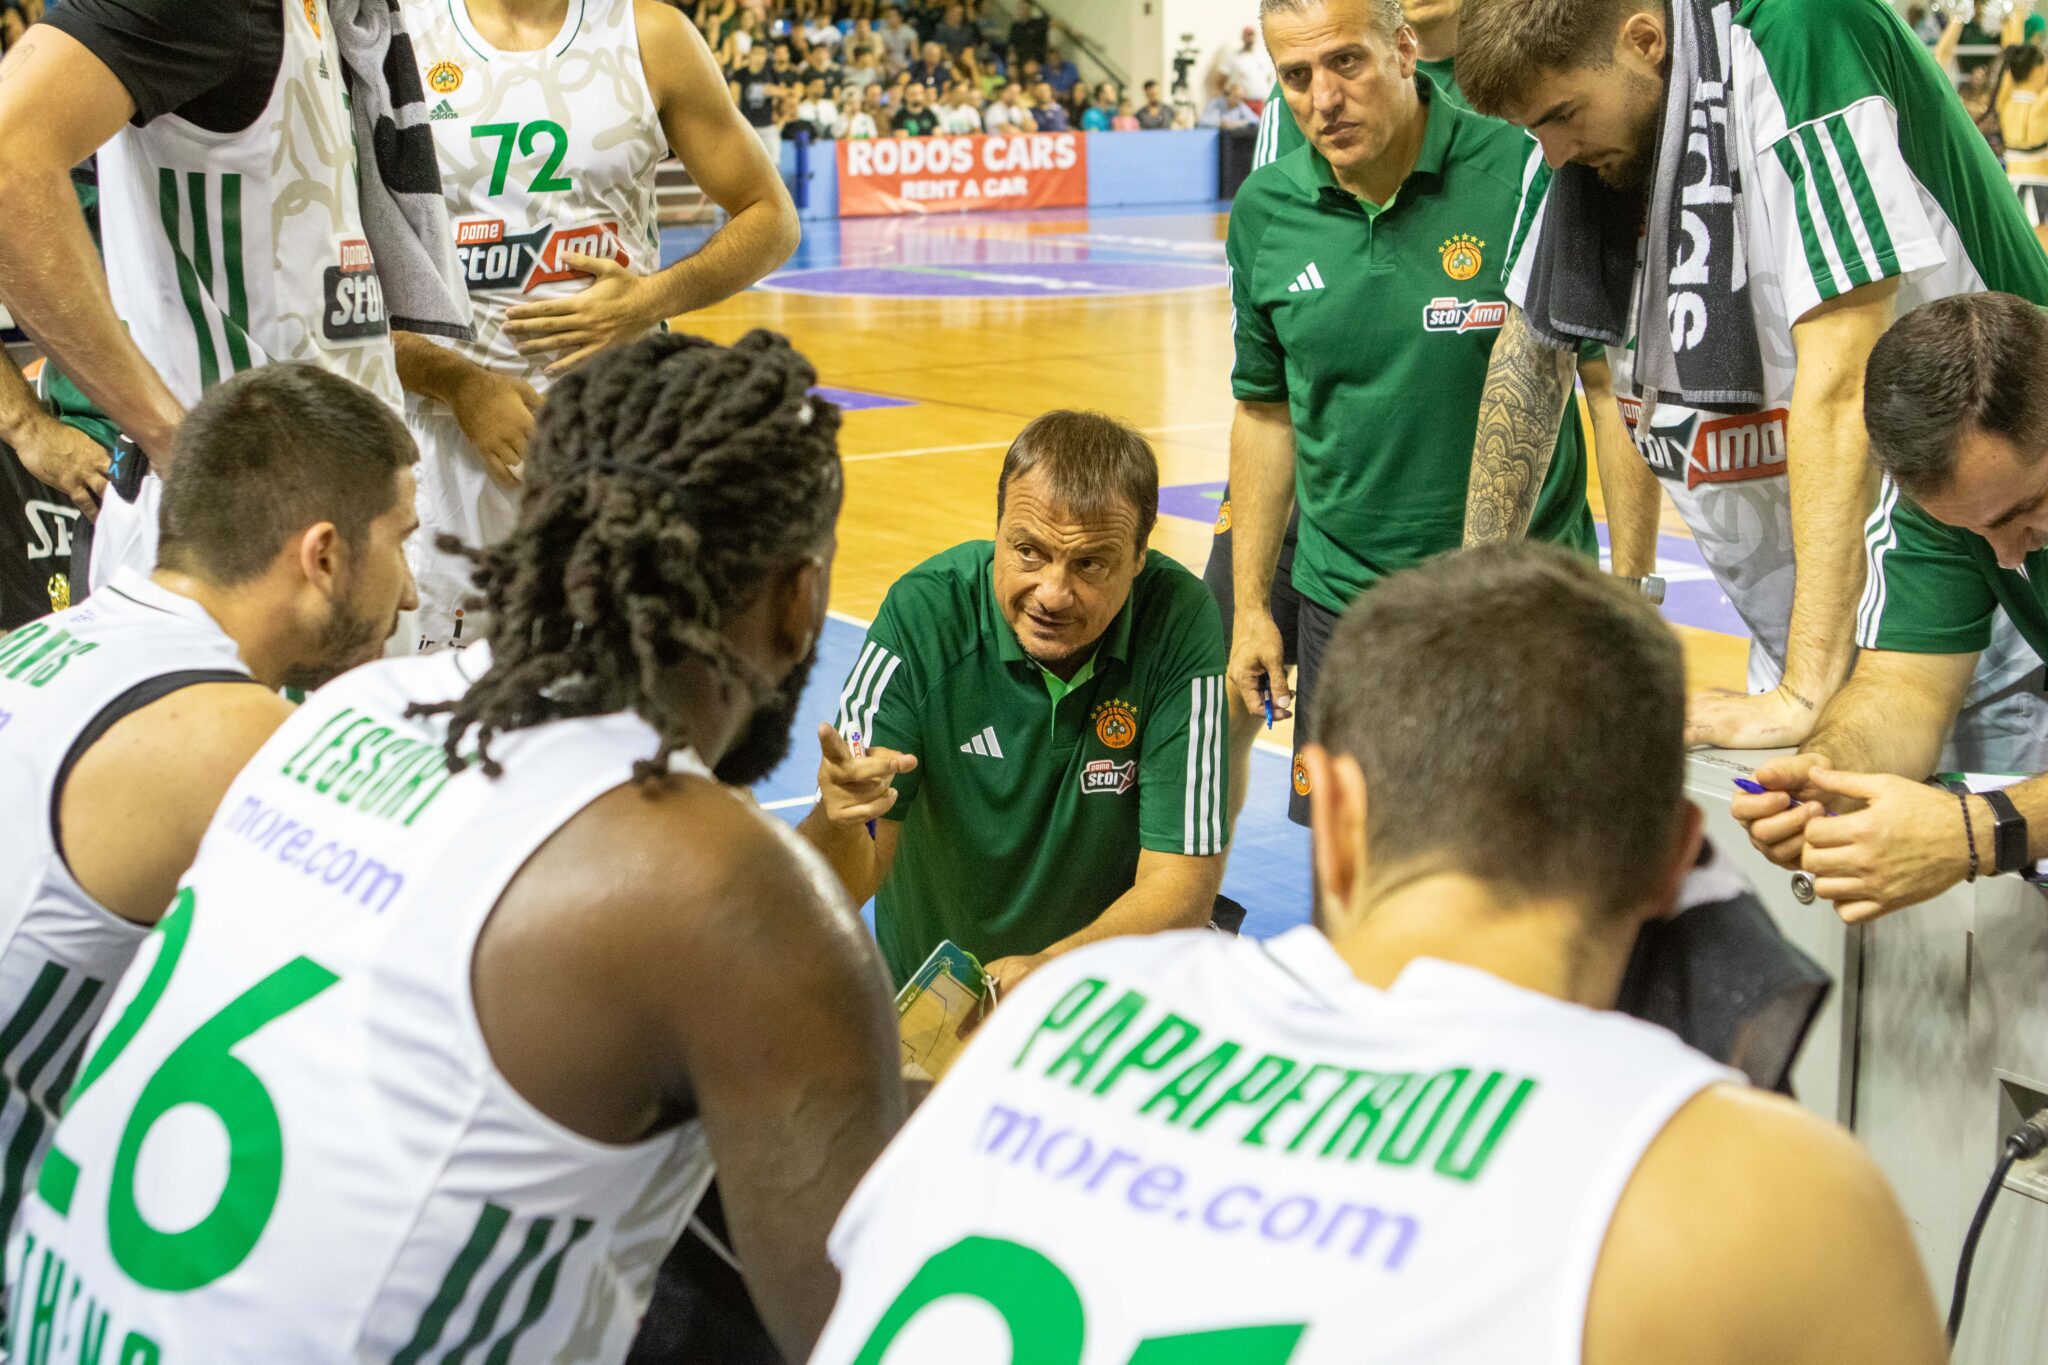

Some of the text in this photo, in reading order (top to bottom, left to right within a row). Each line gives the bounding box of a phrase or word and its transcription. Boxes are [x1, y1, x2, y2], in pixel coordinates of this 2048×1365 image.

[470, 119, 573, 197] 72
[848, 134, 1078, 176] RODOS CARS
[901, 176, 1029, 200] RENT A CAR
[461, 223, 499, 243] pame
[1011, 977, 1539, 1182] PAPAPETROU
[977, 1103, 1420, 1272] more.com
